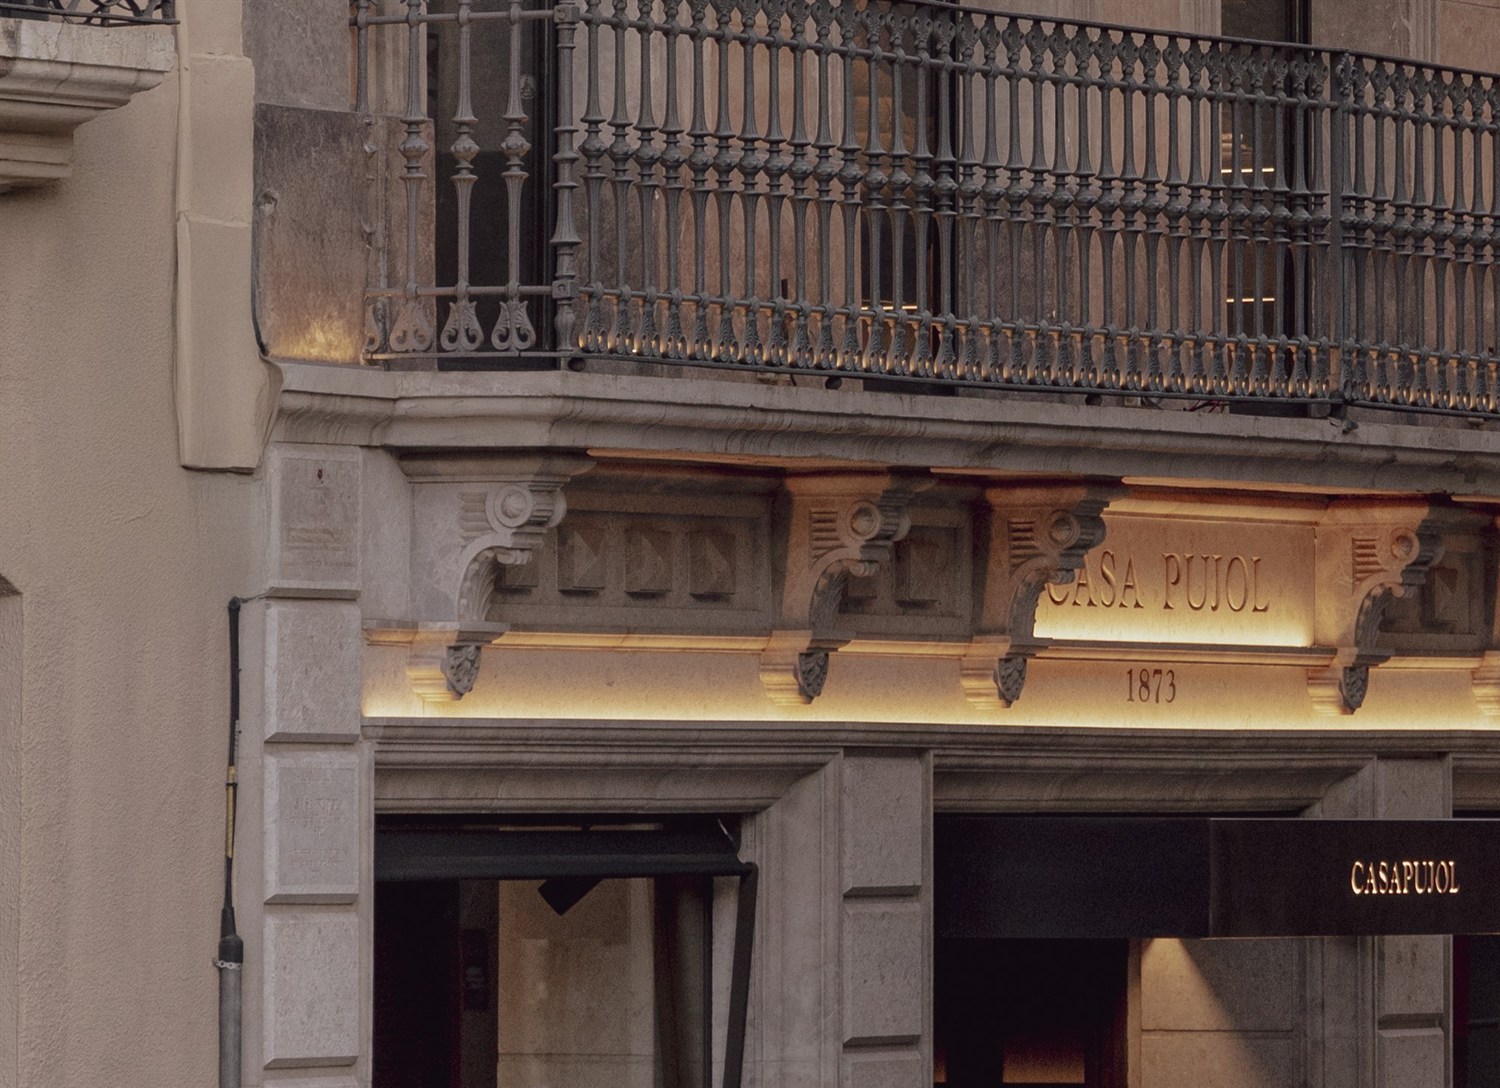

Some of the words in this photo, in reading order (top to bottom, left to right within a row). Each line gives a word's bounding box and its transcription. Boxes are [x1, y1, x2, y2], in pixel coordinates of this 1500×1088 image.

[1162, 552, 1271, 613] PUJOL
[1126, 668, 1177, 704] 1873
[1351, 860, 1461, 895] CASAPUJOL
